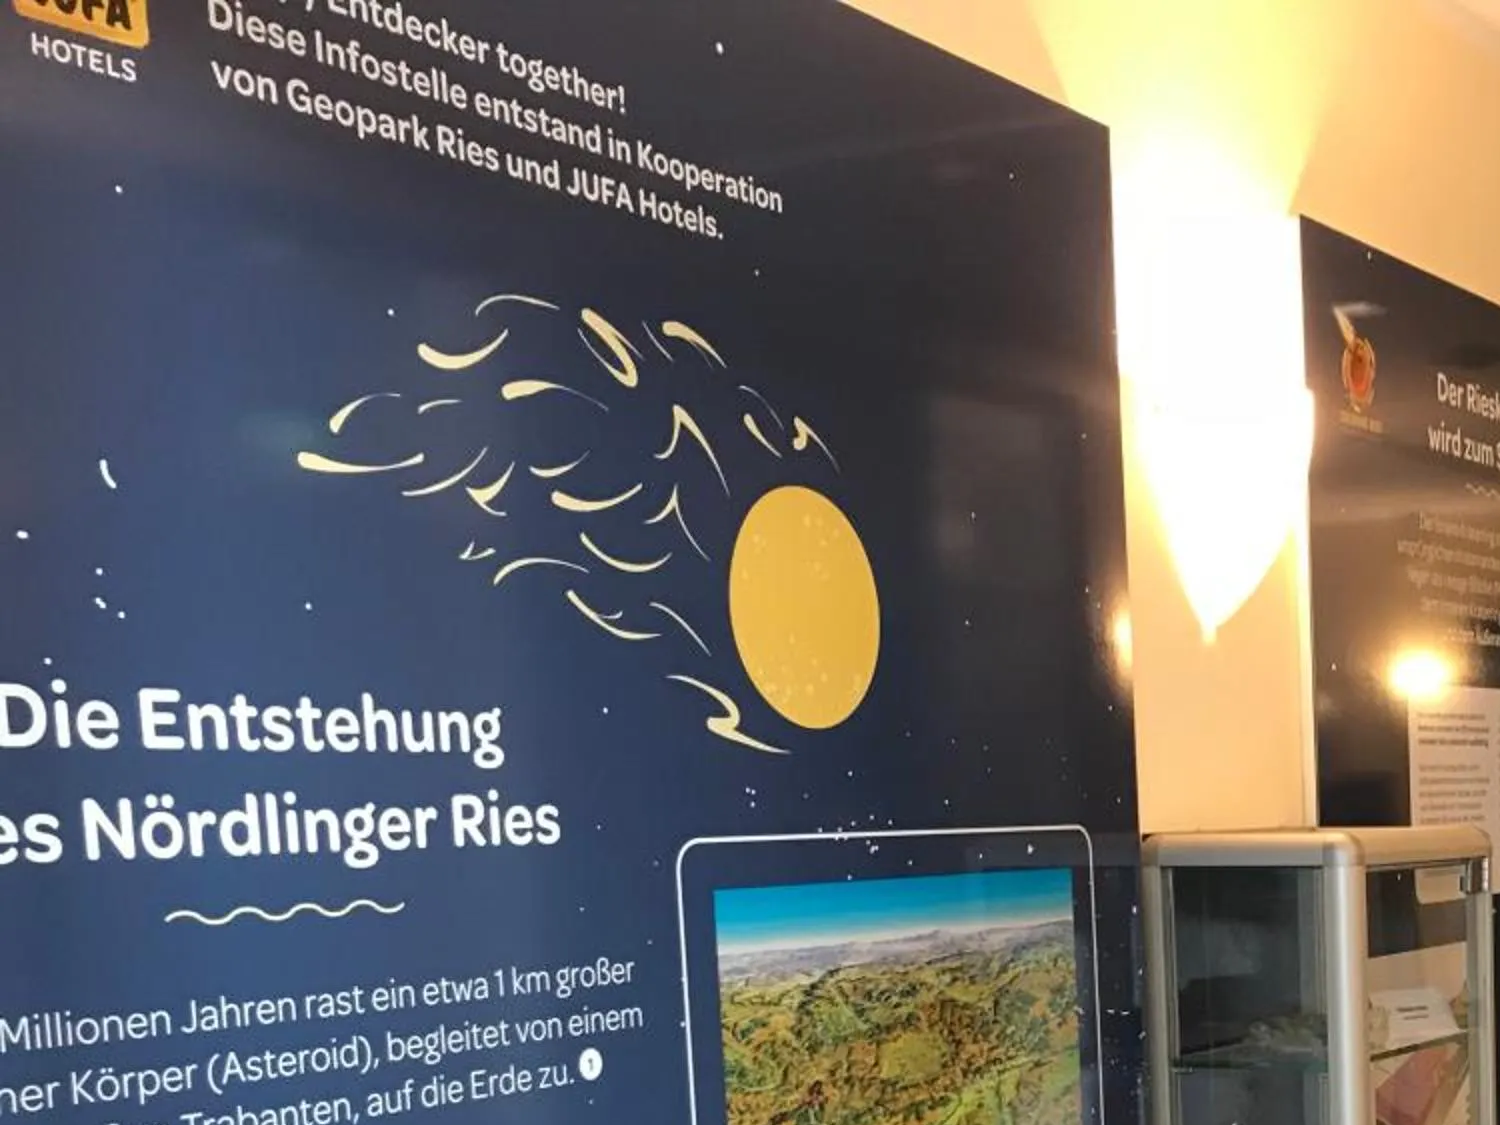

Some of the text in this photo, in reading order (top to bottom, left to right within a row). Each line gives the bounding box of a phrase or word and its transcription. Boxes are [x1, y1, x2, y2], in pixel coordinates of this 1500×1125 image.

[33, 0, 132, 31] UFA
[31, 32, 137, 83] HOTELS
[495, 42, 626, 114] together!
[207, 0, 783, 213] Diese Infostelle entstand in Kooperation
[210, 60, 724, 240] von Geopark Ries und JUFA Hotels.
[1437, 372, 1463, 408] Der
[1428, 422, 1462, 458] wird
[1464, 438, 1495, 468] zum
[0, 679, 505, 769] Die Entstehung
[81, 791, 438, 867] Nördlinger
[451, 788, 561, 848] Ries
[0, 956, 635, 1054] Millionen Jahren rast ein etwa 1 km großer
[71, 1063, 198, 1105] Körper
[207, 1035, 380, 1095] (Asteroid),
[386, 1020, 511, 1065] begleitet
[515, 1017, 563, 1043] von
[567, 1005, 643, 1037] einem
[366, 1078, 415, 1117] auf
[420, 1074, 464, 1108] die
[469, 1064, 533, 1100] Erde
[537, 1064, 575, 1089] zu.
